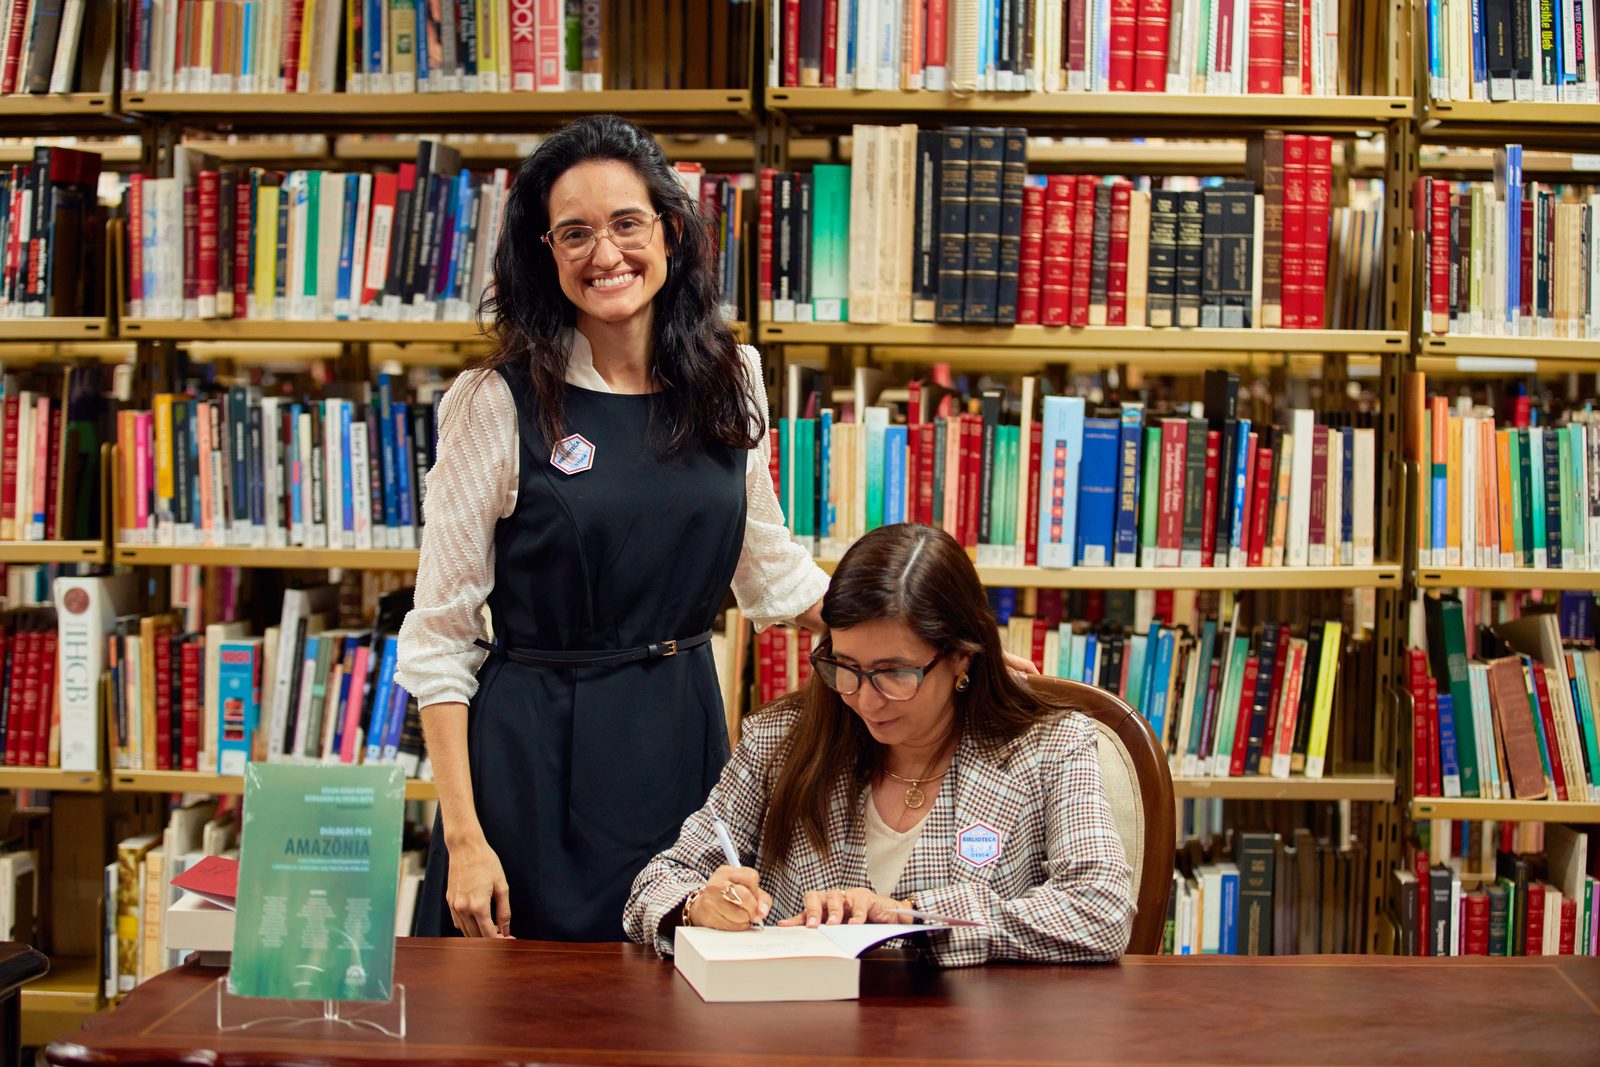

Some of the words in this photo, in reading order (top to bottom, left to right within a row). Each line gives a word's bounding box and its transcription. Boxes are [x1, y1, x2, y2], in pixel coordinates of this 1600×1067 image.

[1542, 31, 1553, 50] Web
[1575, 23, 1583, 61] DRAGONS
[284, 836, 370, 856] AMAZÔNIA
